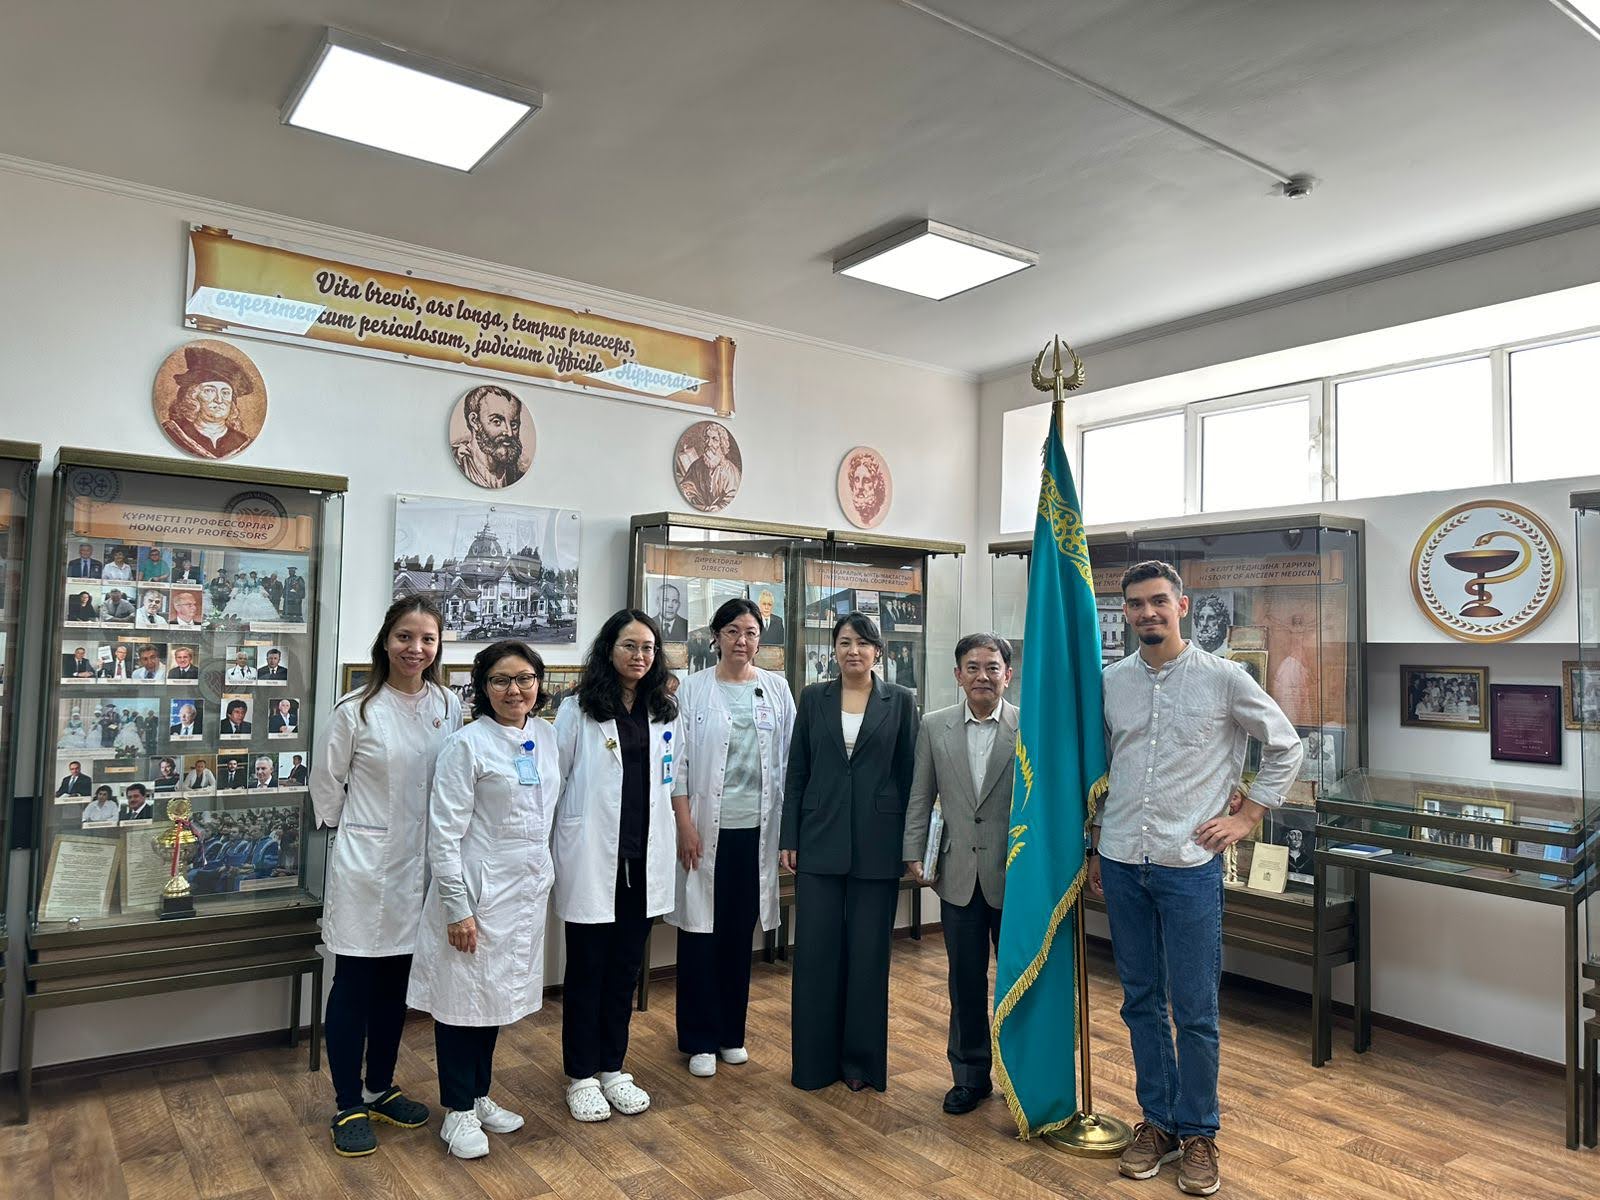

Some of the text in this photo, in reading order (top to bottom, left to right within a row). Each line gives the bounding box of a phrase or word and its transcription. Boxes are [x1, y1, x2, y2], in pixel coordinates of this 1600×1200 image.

[316, 271, 636, 357] Vita brevis, ars longa, tempus praeceps,
[359, 316, 470, 353] periculosum,
[472, 332, 544, 362] judicium
[184, 516, 274, 531] ПРОФЕССОРЛАР
[128, 523, 268, 540] HONORARY PROFESSORS
[701, 565, 738, 573] DIRECTORS
[1236, 563, 1279, 572] МЕДИЦИНА
[1282, 560, 1317, 570] ТАРИХЫ
[1199, 573, 1232, 582] HISTORY
[1245, 571, 1280, 579] ANCIENT
[1281, 569, 1321, 578] MEDICINE
